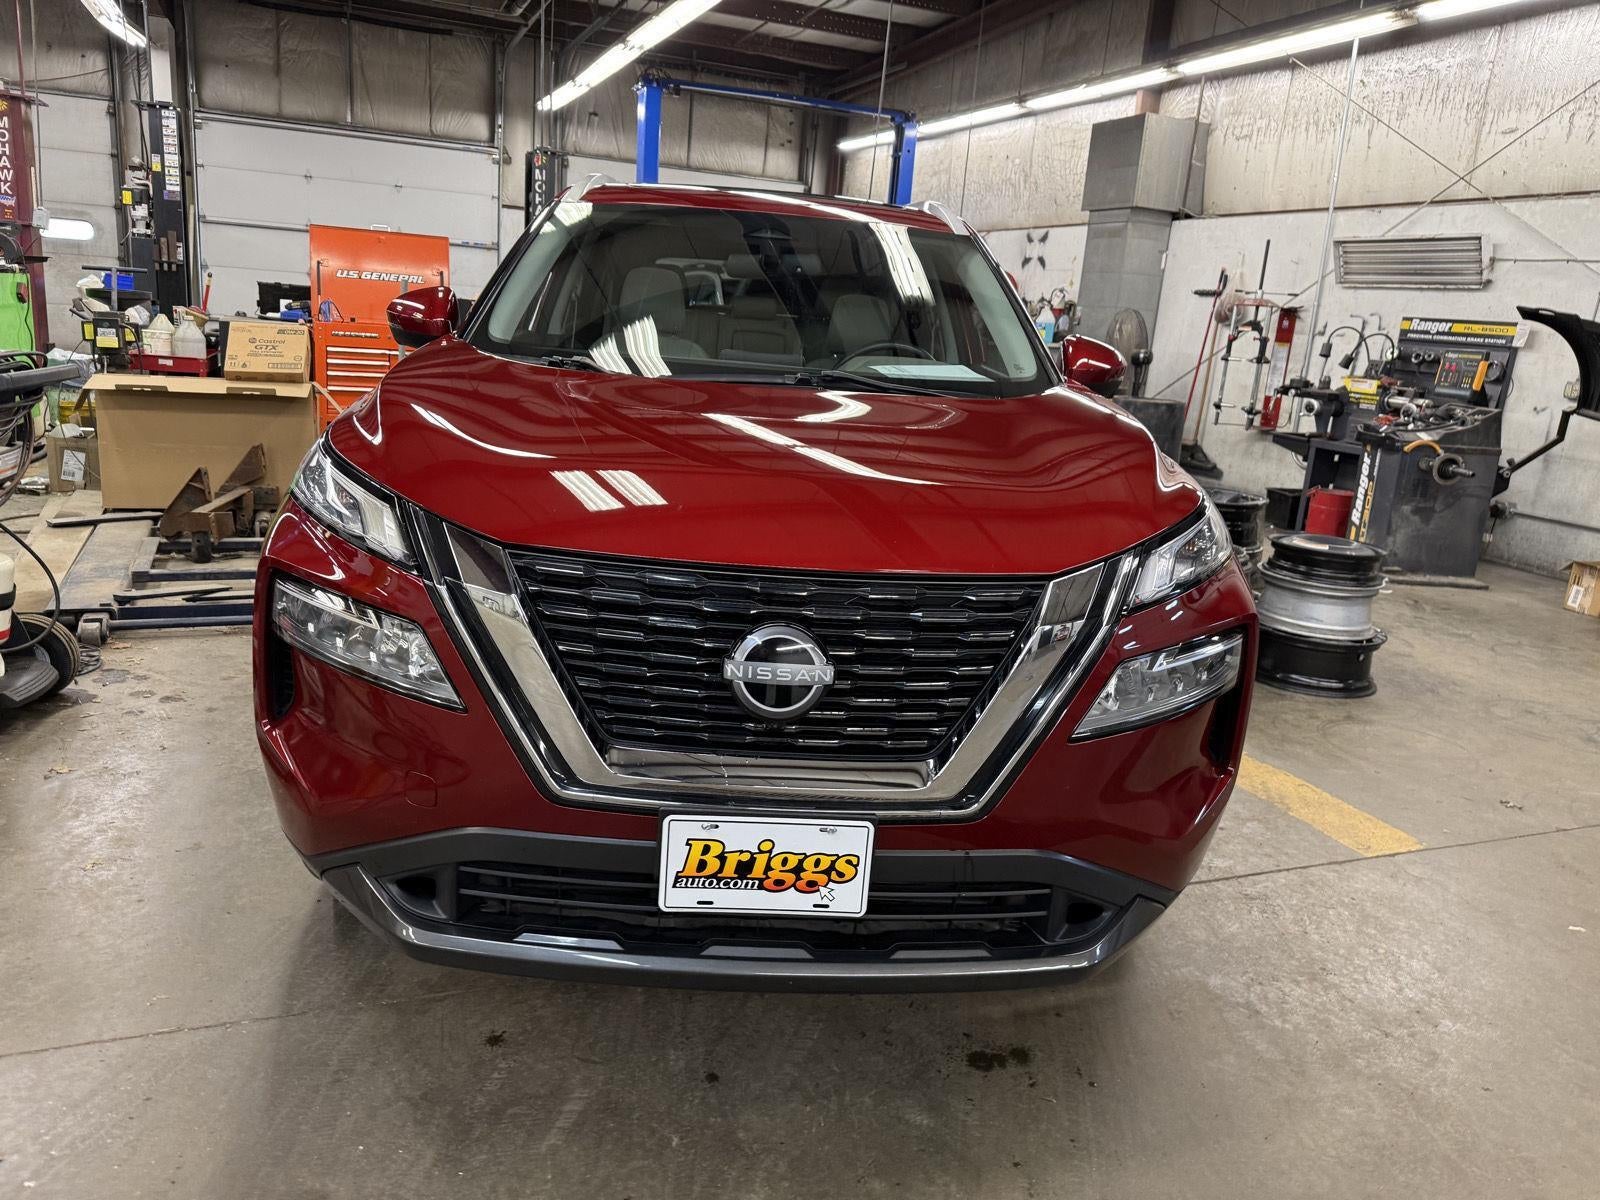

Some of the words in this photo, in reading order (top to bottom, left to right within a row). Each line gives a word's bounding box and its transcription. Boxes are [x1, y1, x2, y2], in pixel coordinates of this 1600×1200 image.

[0, 116, 13, 195] MOHAWK
[533, 168, 545, 218] MOHA
[1410, 318, 1452, 333] Ranger
[1351, 451, 1371, 526] Ranger
[725, 663, 831, 683] NISSAN
[675, 876, 760, 891] auto.com
[677, 838, 860, 894] Briggs
